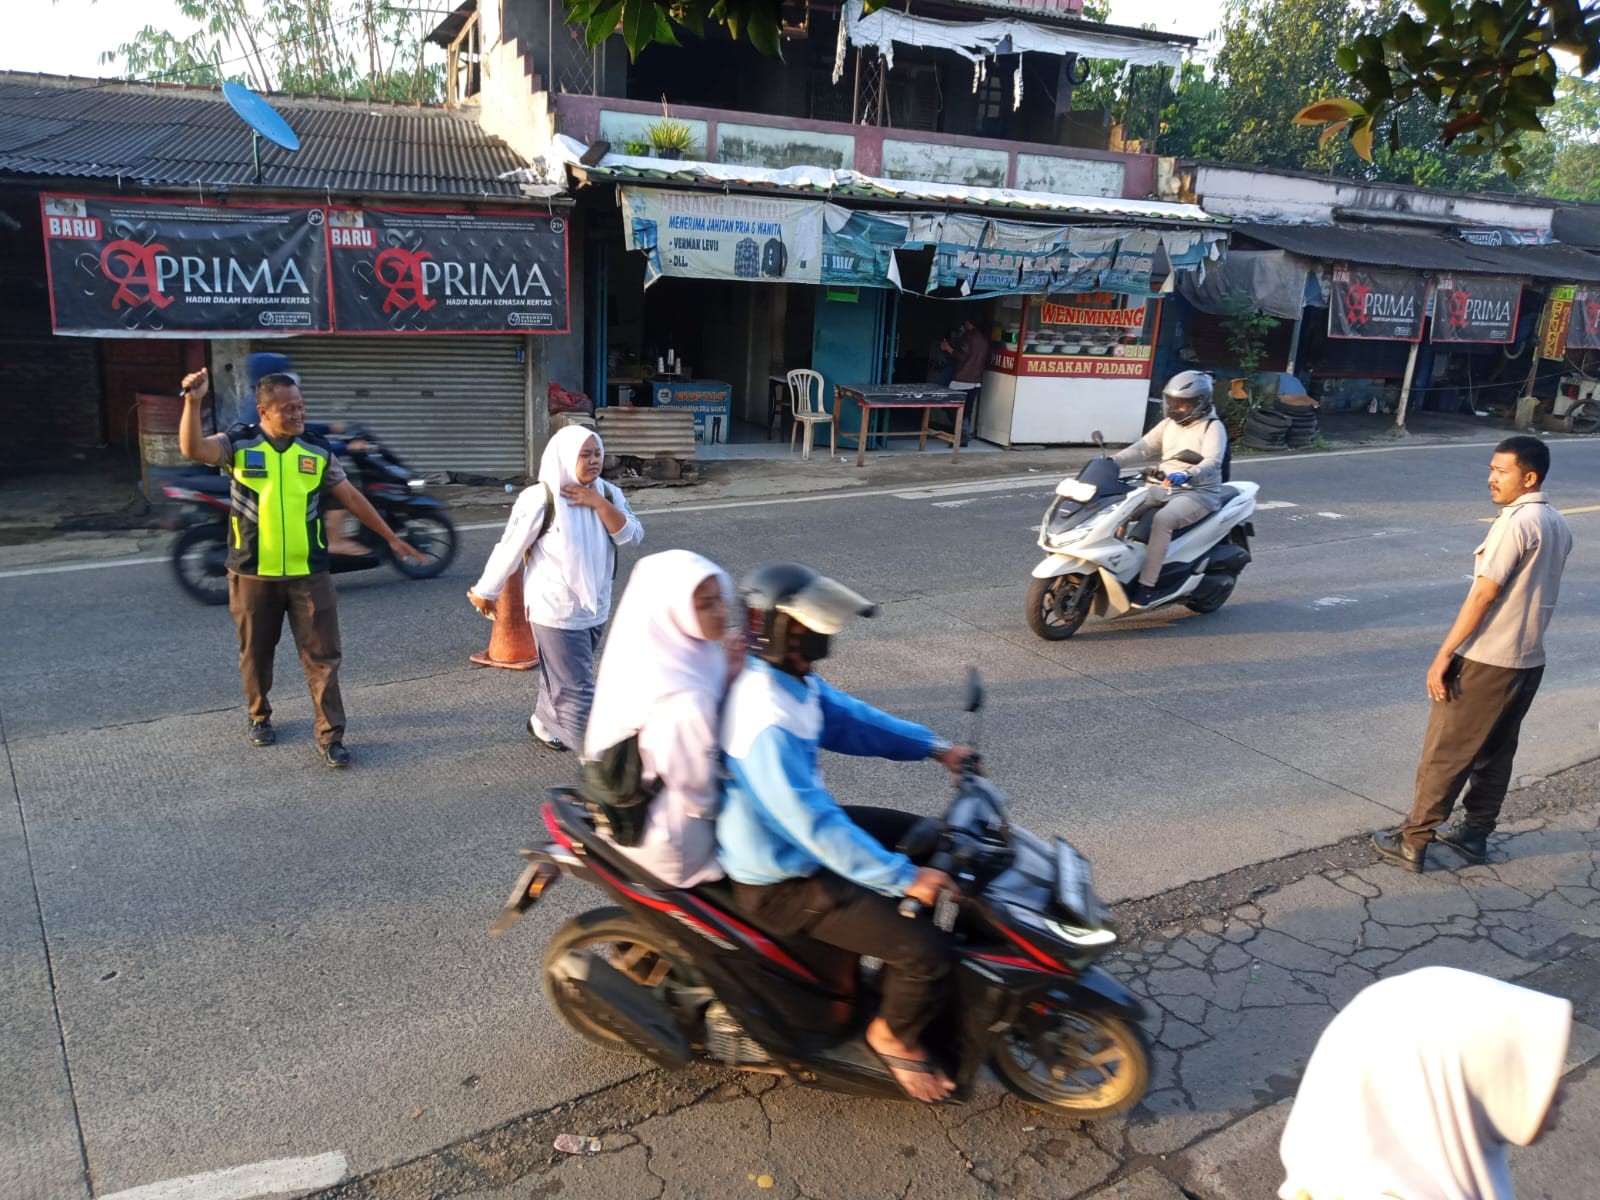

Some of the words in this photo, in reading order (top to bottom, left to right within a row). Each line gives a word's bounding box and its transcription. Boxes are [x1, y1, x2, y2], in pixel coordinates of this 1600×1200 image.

[49, 218, 97, 238] BARU
[669, 215, 705, 231] MENERIMA
[706, 218, 733, 233] JAHITAN
[735, 220, 750, 234] PRIA
[751, 221, 756, 235] &
[757, 222, 782, 236] WANITA
[331, 229, 372, 246] BARU
[673, 237, 701, 251] VERMAK
[186, 296, 212, 304] HADIR
[213, 296, 241, 304] DALAM
[242, 296, 280, 304] KEMASAN
[281, 297, 311, 305] KERTAS
[446, 298, 468, 306] HADIR
[469, 298, 493, 306] DALAM
[1041, 303, 1081, 324] WENI
[1083, 305, 1146, 327] MINANG
[1027, 361, 1092, 374] MASAKAN
[1096, 362, 1143, 376] PADANG
